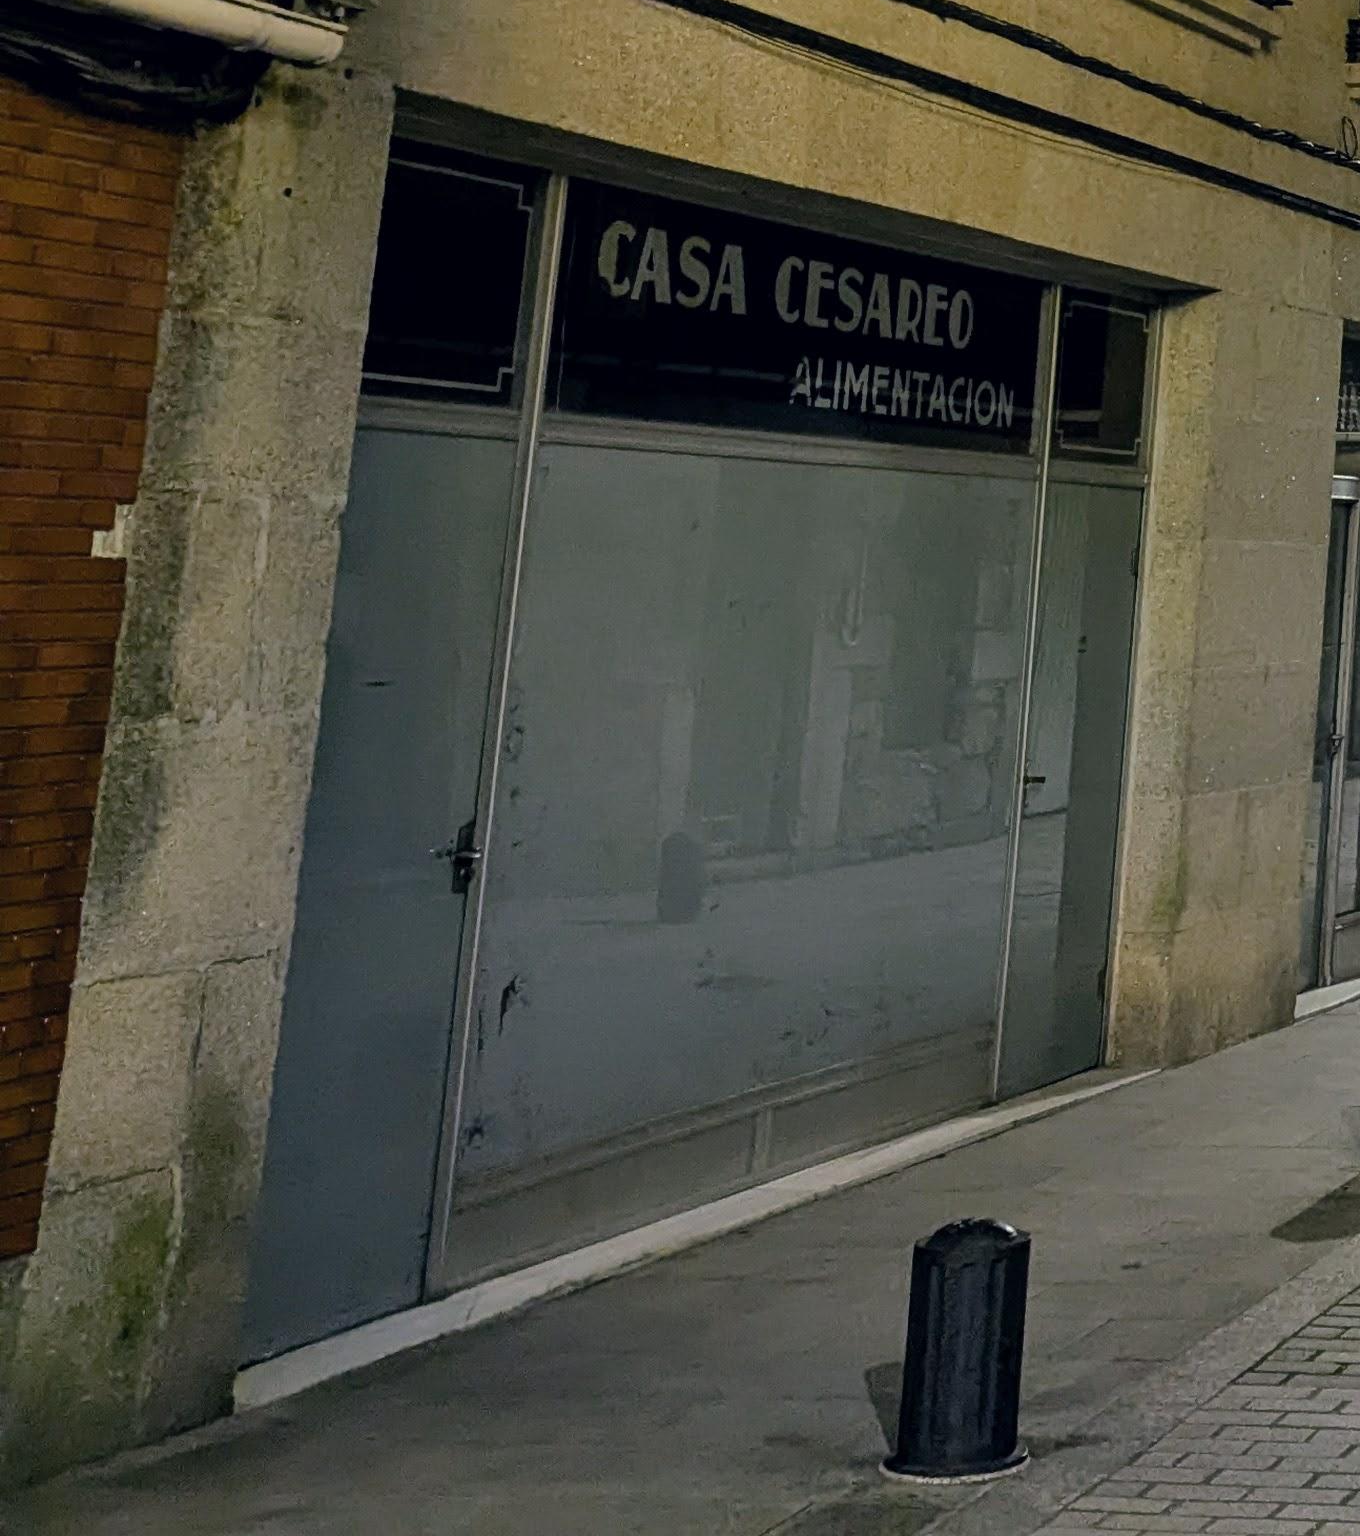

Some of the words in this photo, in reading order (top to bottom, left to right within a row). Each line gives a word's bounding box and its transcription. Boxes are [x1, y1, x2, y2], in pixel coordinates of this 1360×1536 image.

[598, 219, 748, 316] CASA
[774, 255, 976, 350] CESAREO
[788, 355, 1015, 429] ALIMENTACION
